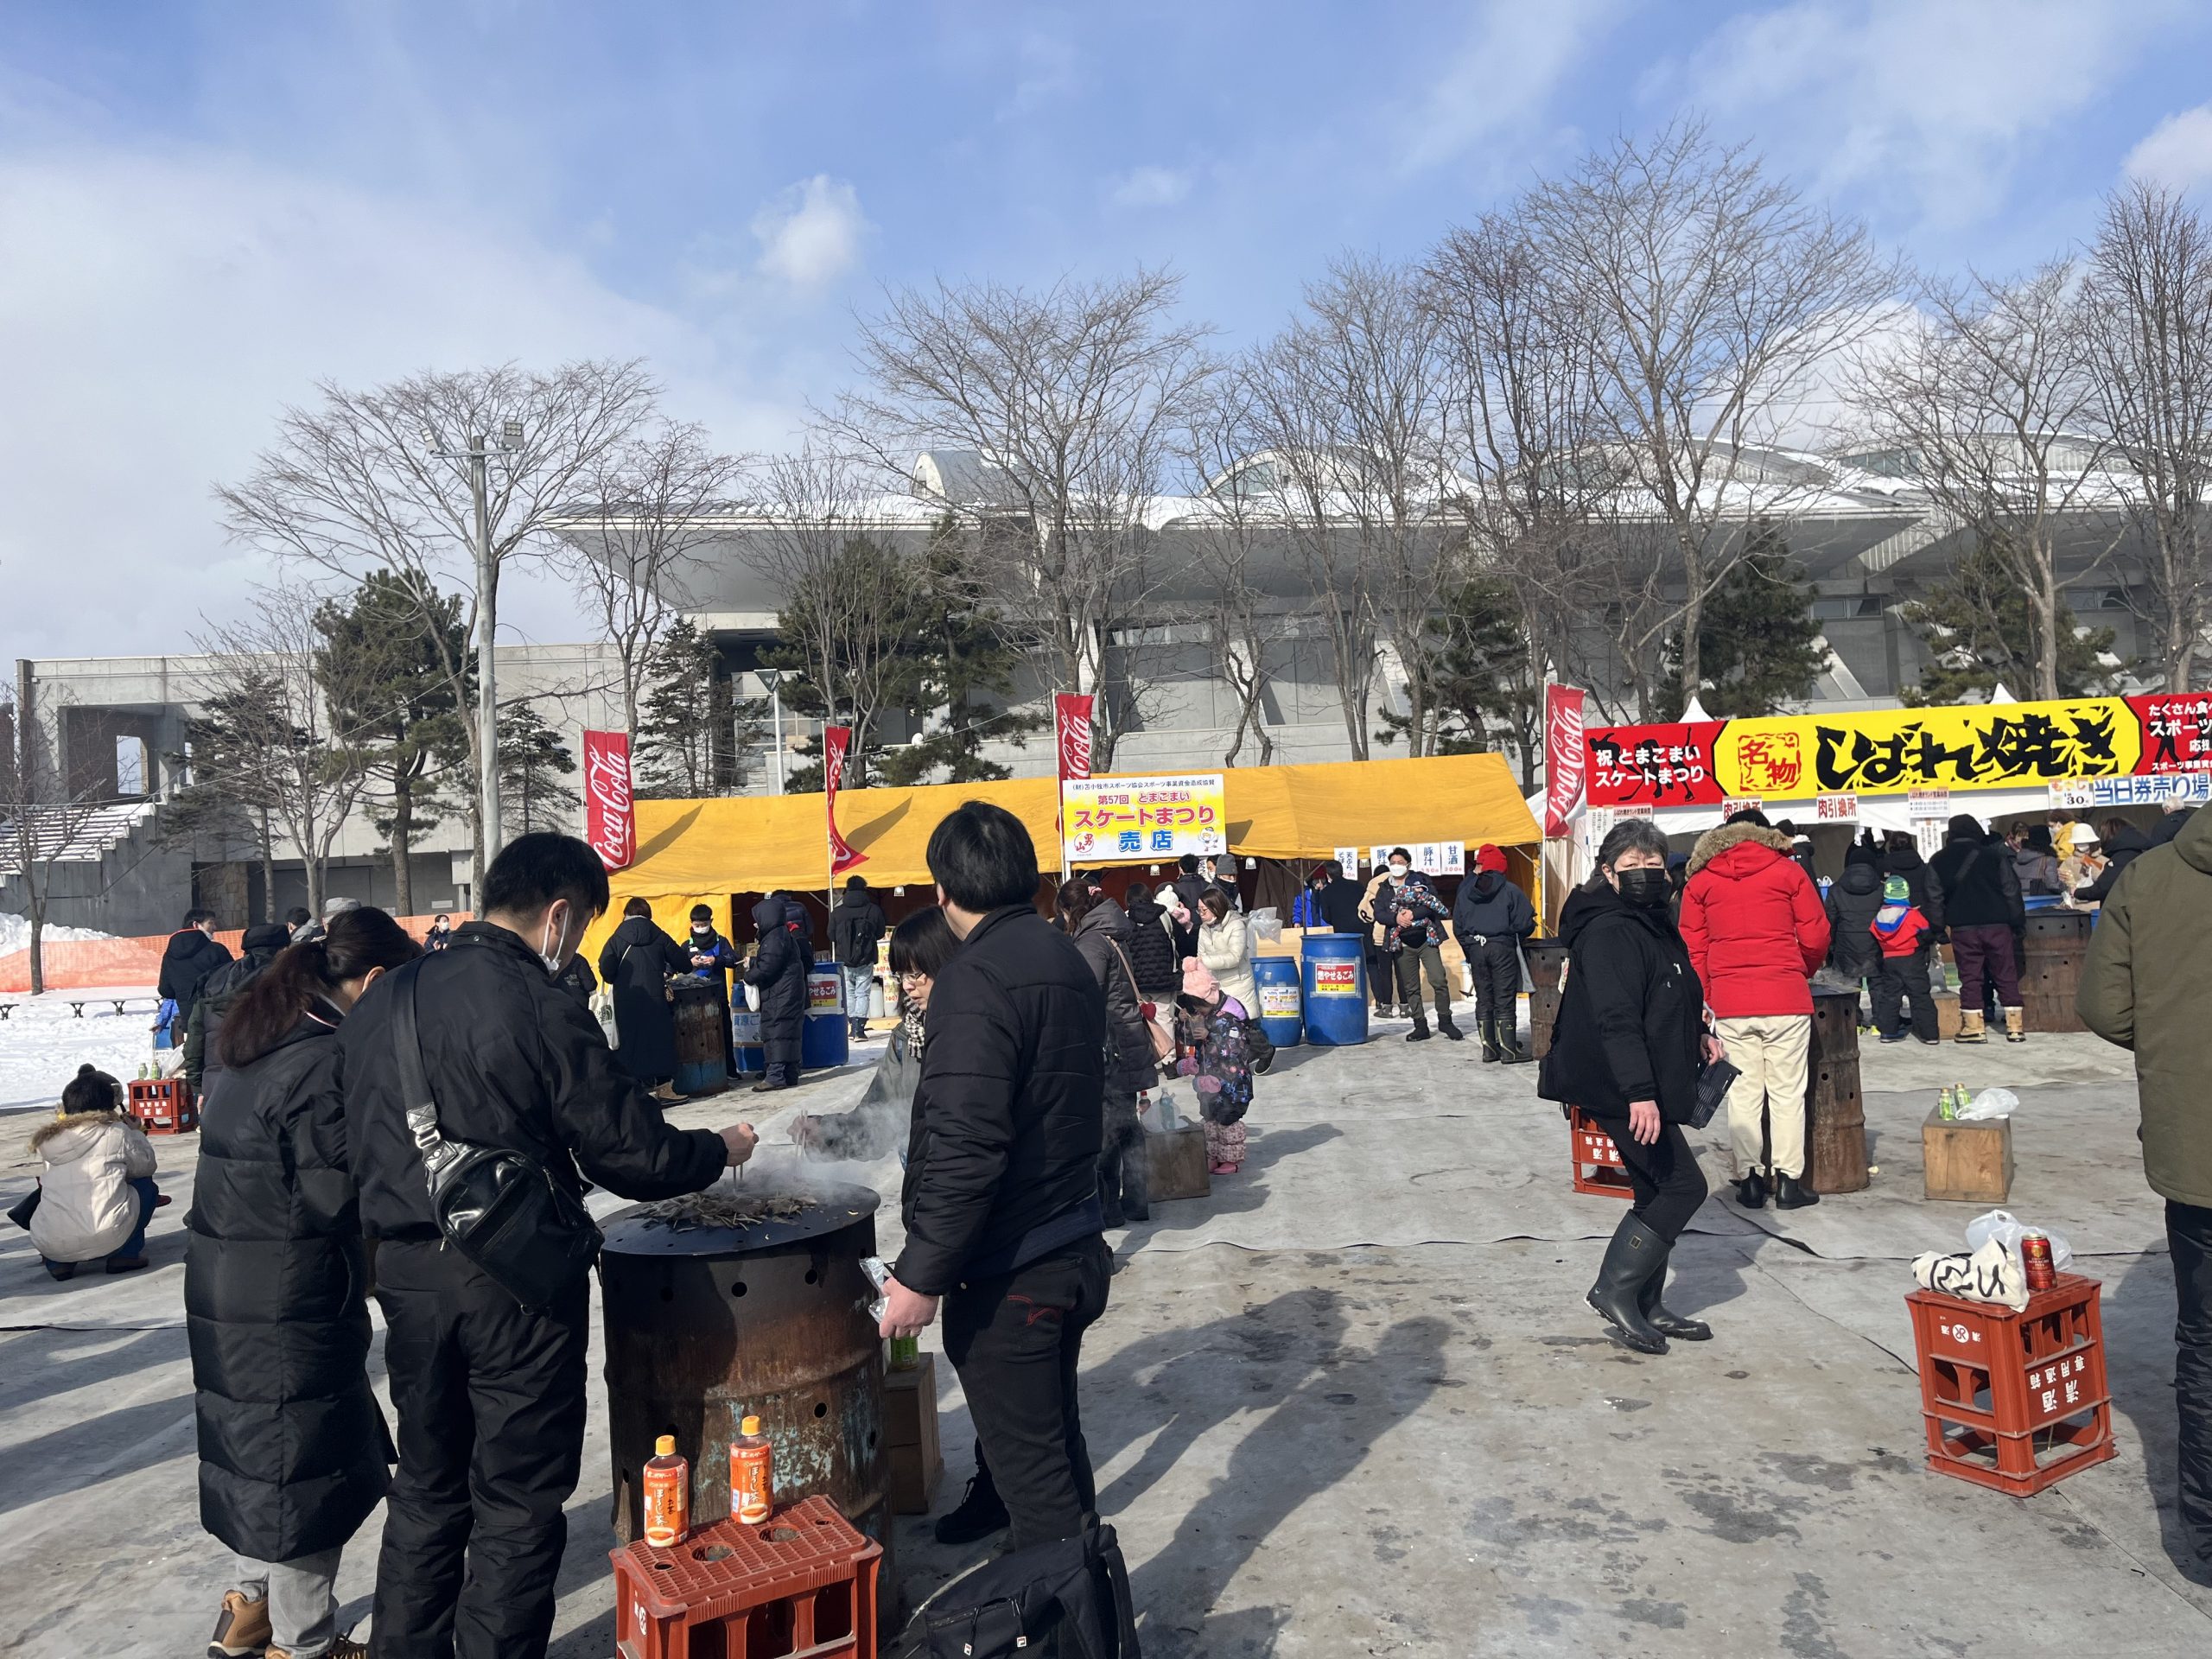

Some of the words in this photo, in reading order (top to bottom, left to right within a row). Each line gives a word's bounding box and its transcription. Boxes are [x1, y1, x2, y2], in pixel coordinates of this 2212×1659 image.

[1596, 749, 1613, 766] 祝
[1618, 745, 1701, 766] とまこまい
[1815, 706, 2119, 791] しばれ焼き
[1739, 740, 1796, 785] 名物
[1595, 765, 1705, 788] スケートまつり
[1097, 794, 1129, 805] 第57回
[1138, 791, 1191, 804] とまこまい
[2094, 774, 2210, 805] 当日券売り場
[1074, 805, 1215, 828] スケートまつり
[1817, 798, 1857, 818] 肉引換所
[1119, 829, 1173, 851] 売店
[1447, 845, 1459, 865] 甘酒
[1317, 970, 1354, 981] 燃やせるごみ
